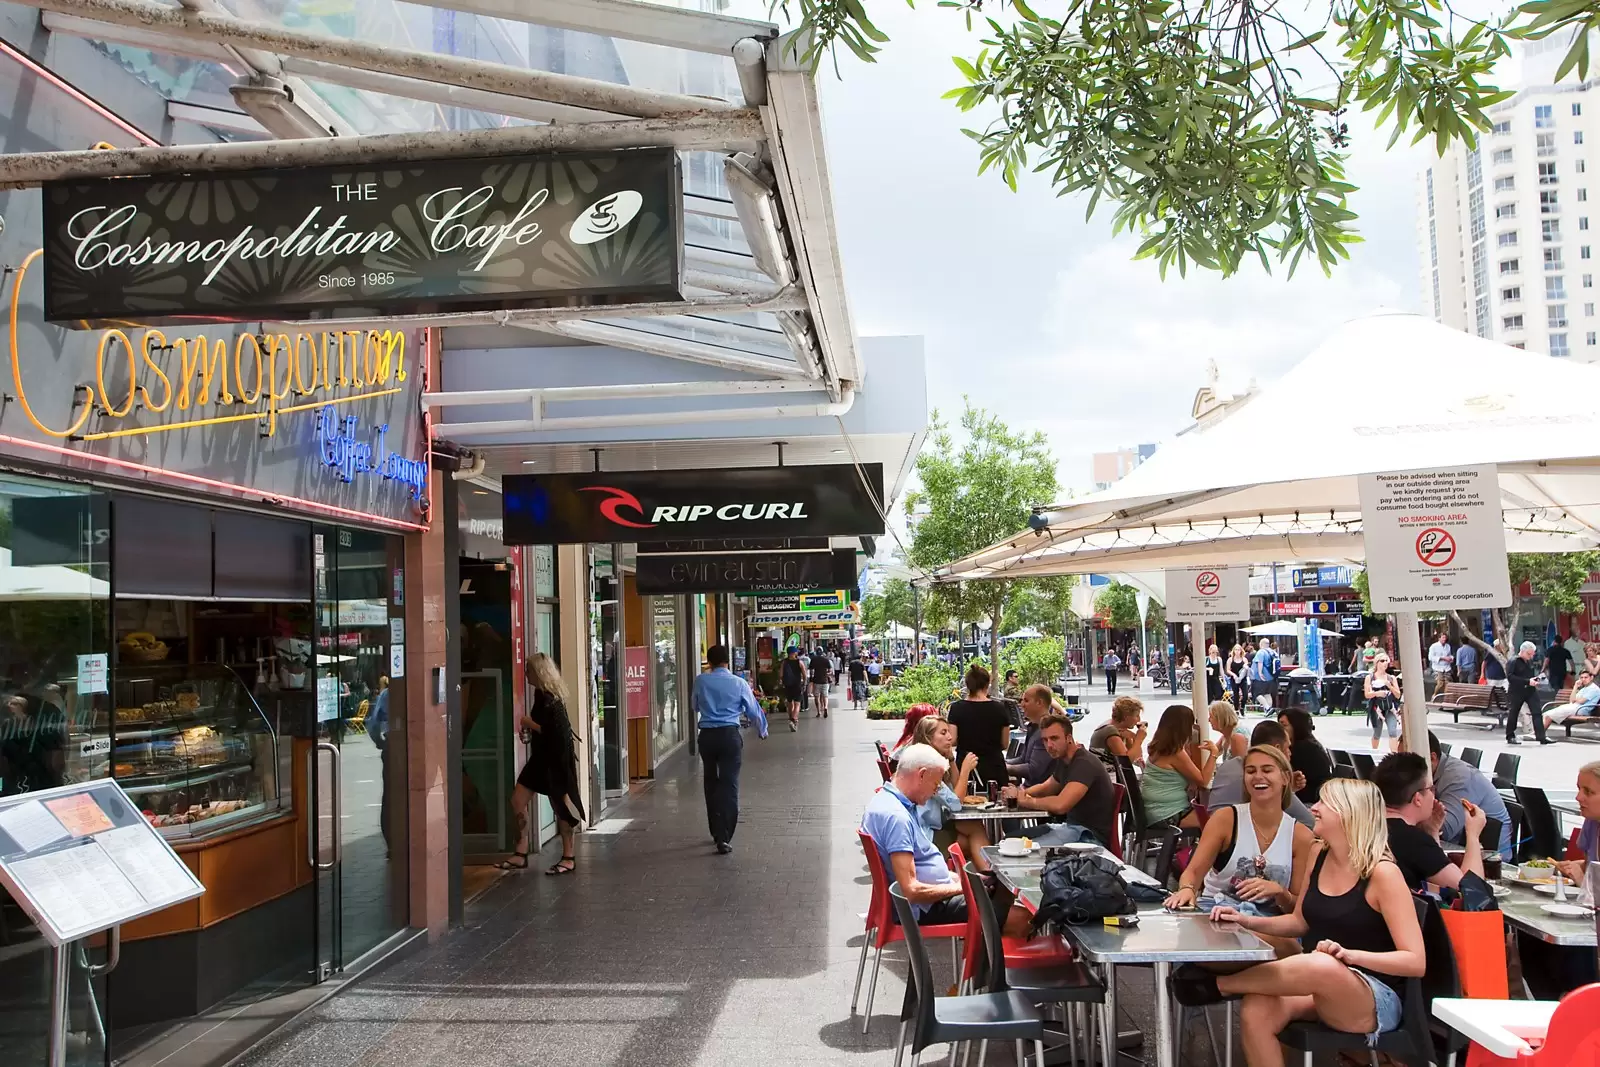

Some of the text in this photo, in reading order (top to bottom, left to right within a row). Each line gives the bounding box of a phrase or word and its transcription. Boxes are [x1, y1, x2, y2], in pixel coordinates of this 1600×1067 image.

[331, 183, 378, 202] THE
[66, 185, 549, 285] Cosmopolitan Cafe
[318, 272, 395, 289] Since 1985
[321, 404, 371, 484] Coffee
[1457, 470, 1478, 478] sitting
[1432, 479, 1454, 487] dining
[1404, 487, 1424, 495] kindly
[1425, 487, 1451, 495] request
[1443, 493, 1456, 501] and
[1425, 501, 1449, 509] bought
[1450, 500, 1485, 508] elsewhere
[651, 502, 809, 523] RIP CURL
[470, 518, 503, 541] RIP CUR
[339, 531, 351, 546] 203
[814, 597, 838, 605] Lotteries
[1452, 592, 1494, 600] cooperation
[751, 612, 853, 623] Internet Cafe
[95, 740, 110, 751] Slide
